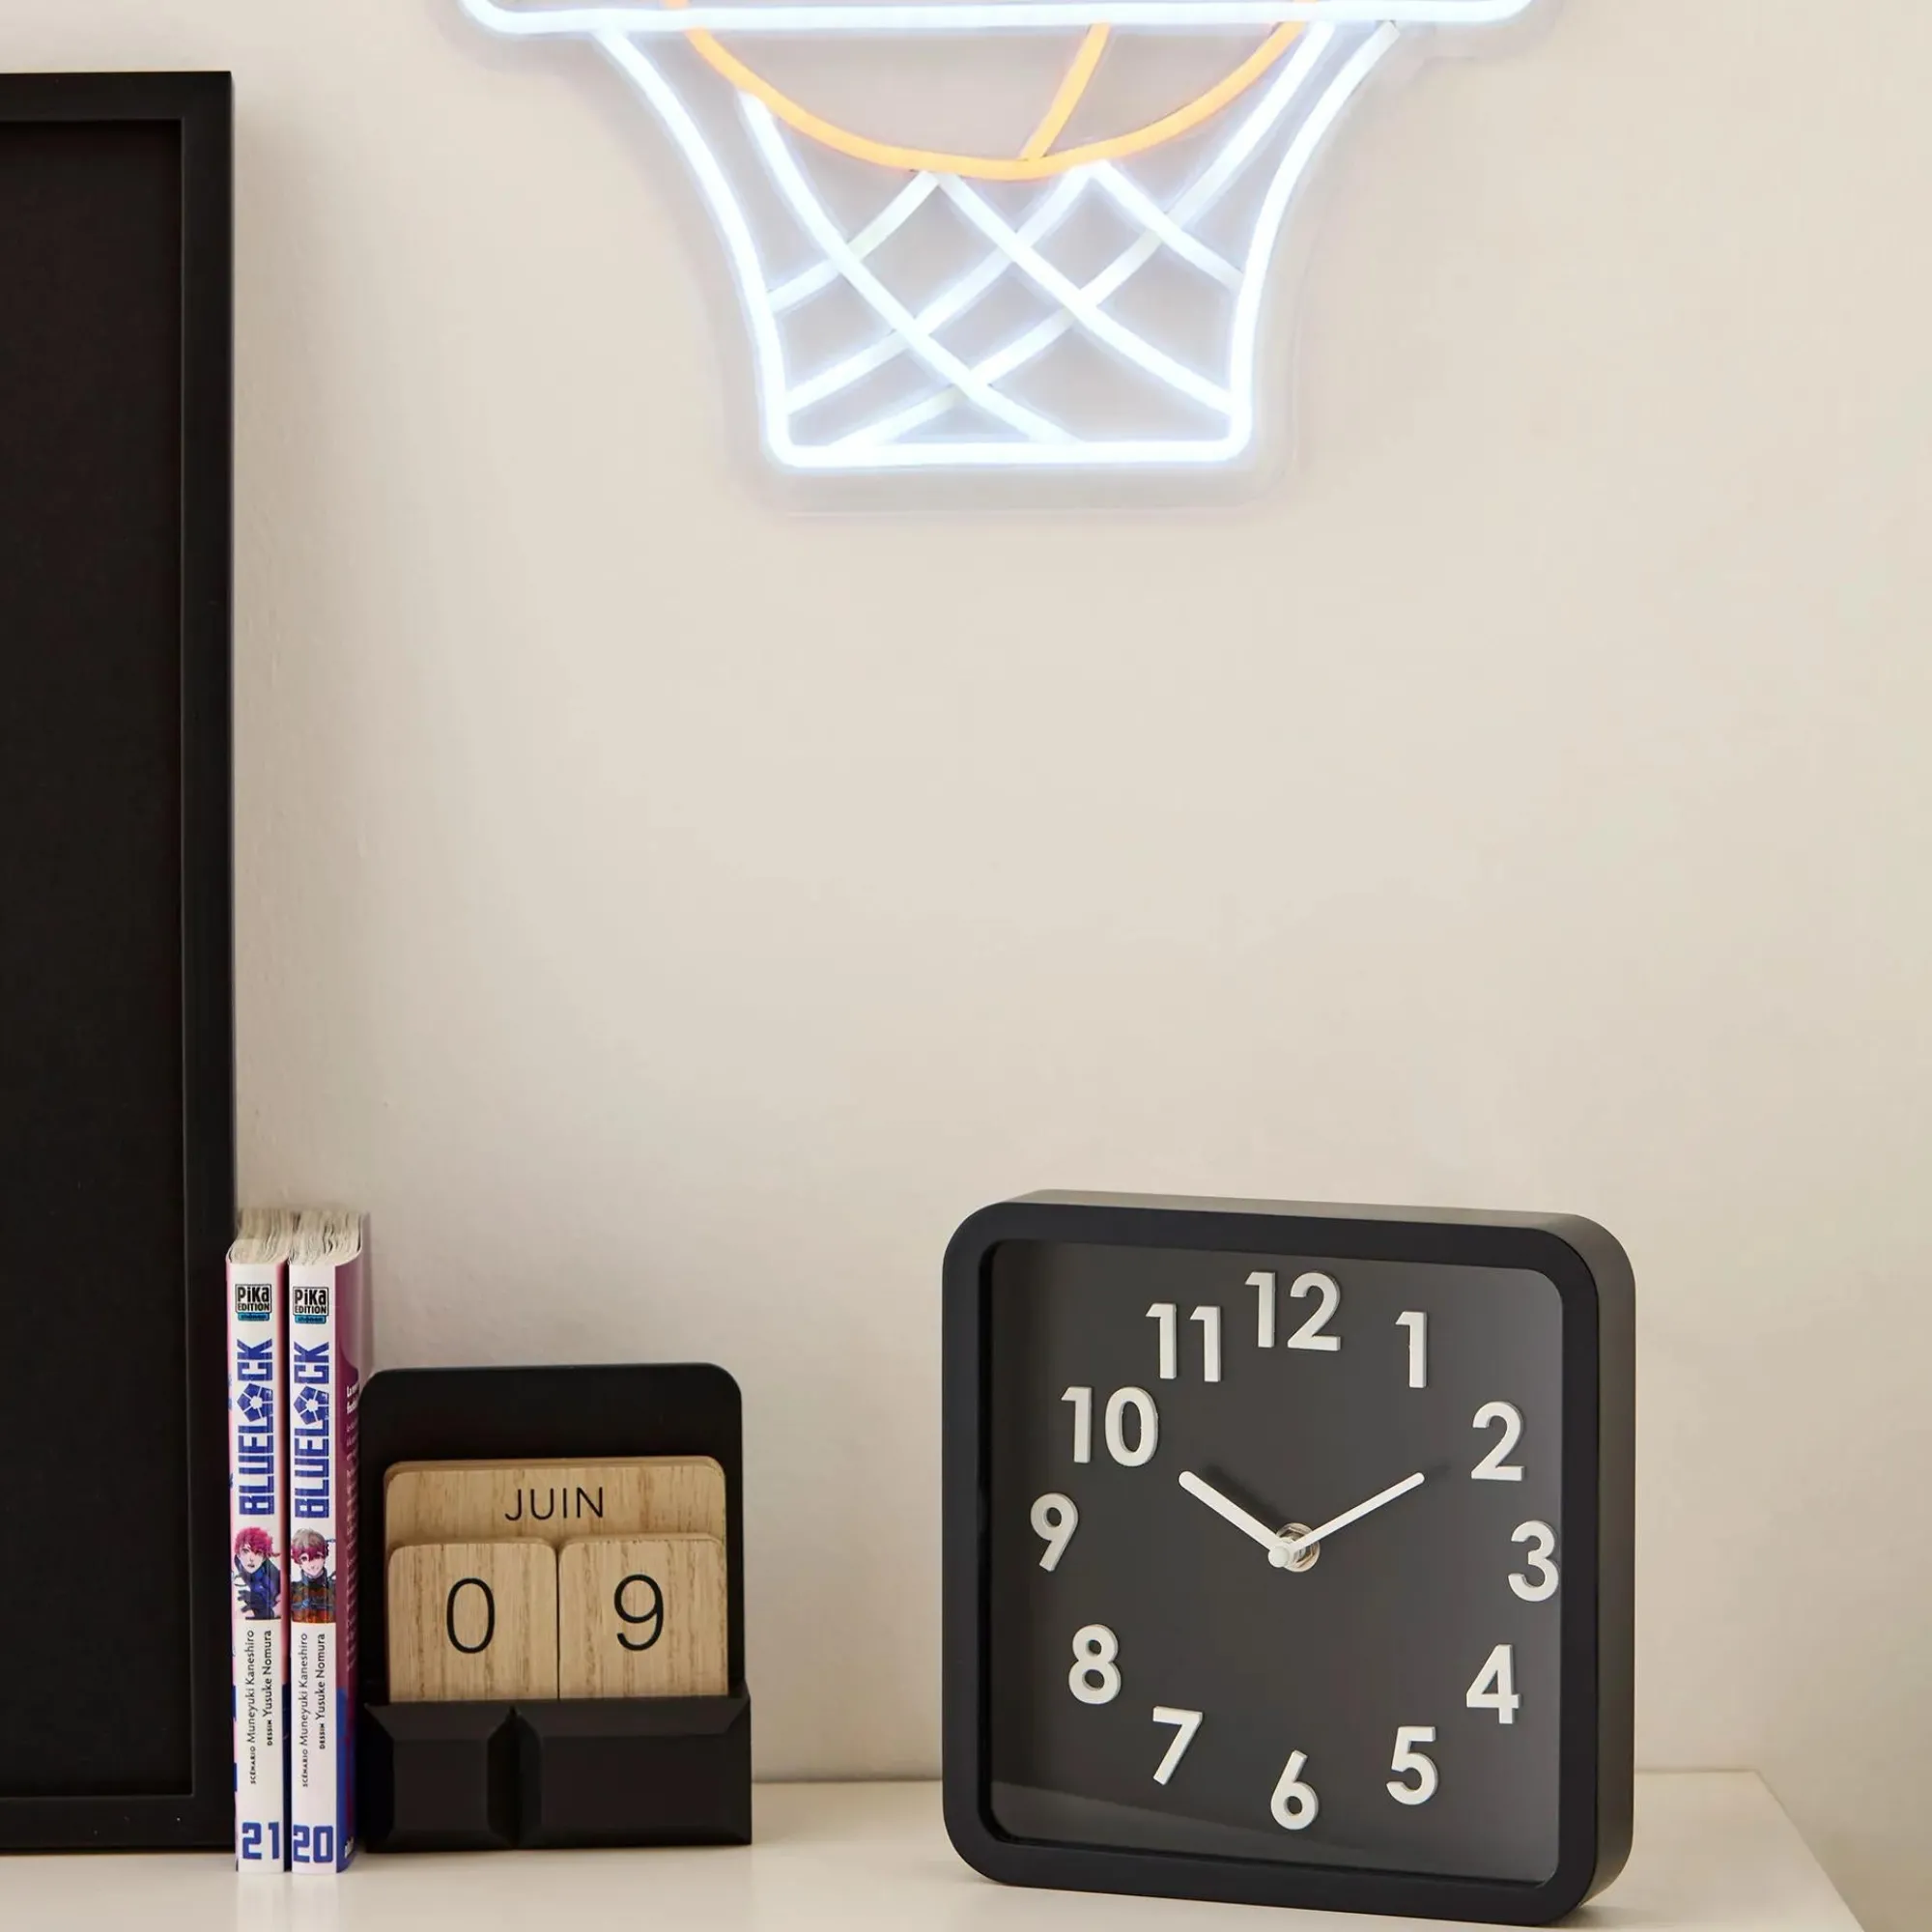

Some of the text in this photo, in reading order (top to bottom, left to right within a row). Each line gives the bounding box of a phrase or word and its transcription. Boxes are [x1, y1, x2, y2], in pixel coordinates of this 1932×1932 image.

[1146, 1302, 1222, 1382] 11
[1245, 1271, 1341, 1351] 12
[1395, 1311, 1428, 1388] 1
[1061, 1386, 1158, 1466] 10
[1471, 1401, 1524, 1481] 2
[504, 1487, 604, 1520] JUIN
[1030, 1492, 1078, 1572] 9
[1508, 1520, 1558, 1602] 3
[262, 1630, 271, 1674] Nomura
[446, 1574, 664, 1654] 0 9
[243, 1630, 254, 1687] Kaneshiro
[298, 1633, 308, 1688] Kaneshiro
[315, 1634, 326, 1678] Nomura
[1068, 1624, 1122, 1705] 8
[1465, 1644, 1520, 1724] 4
[245, 1688, 258, 1744] Muneyuki
[262, 1679, 272, 1717] Yusuke
[298, 1690, 311, 1746] Muneyuki
[315, 1683, 326, 1719] Yusuke
[1152, 1706, 1203, 1785] 7
[1386, 1726, 1438, 1805] 5
[1270, 1750, 1319, 1831] 6
[242, 1822, 280, 1860] 21
[293, 1825, 333, 1862] 20
